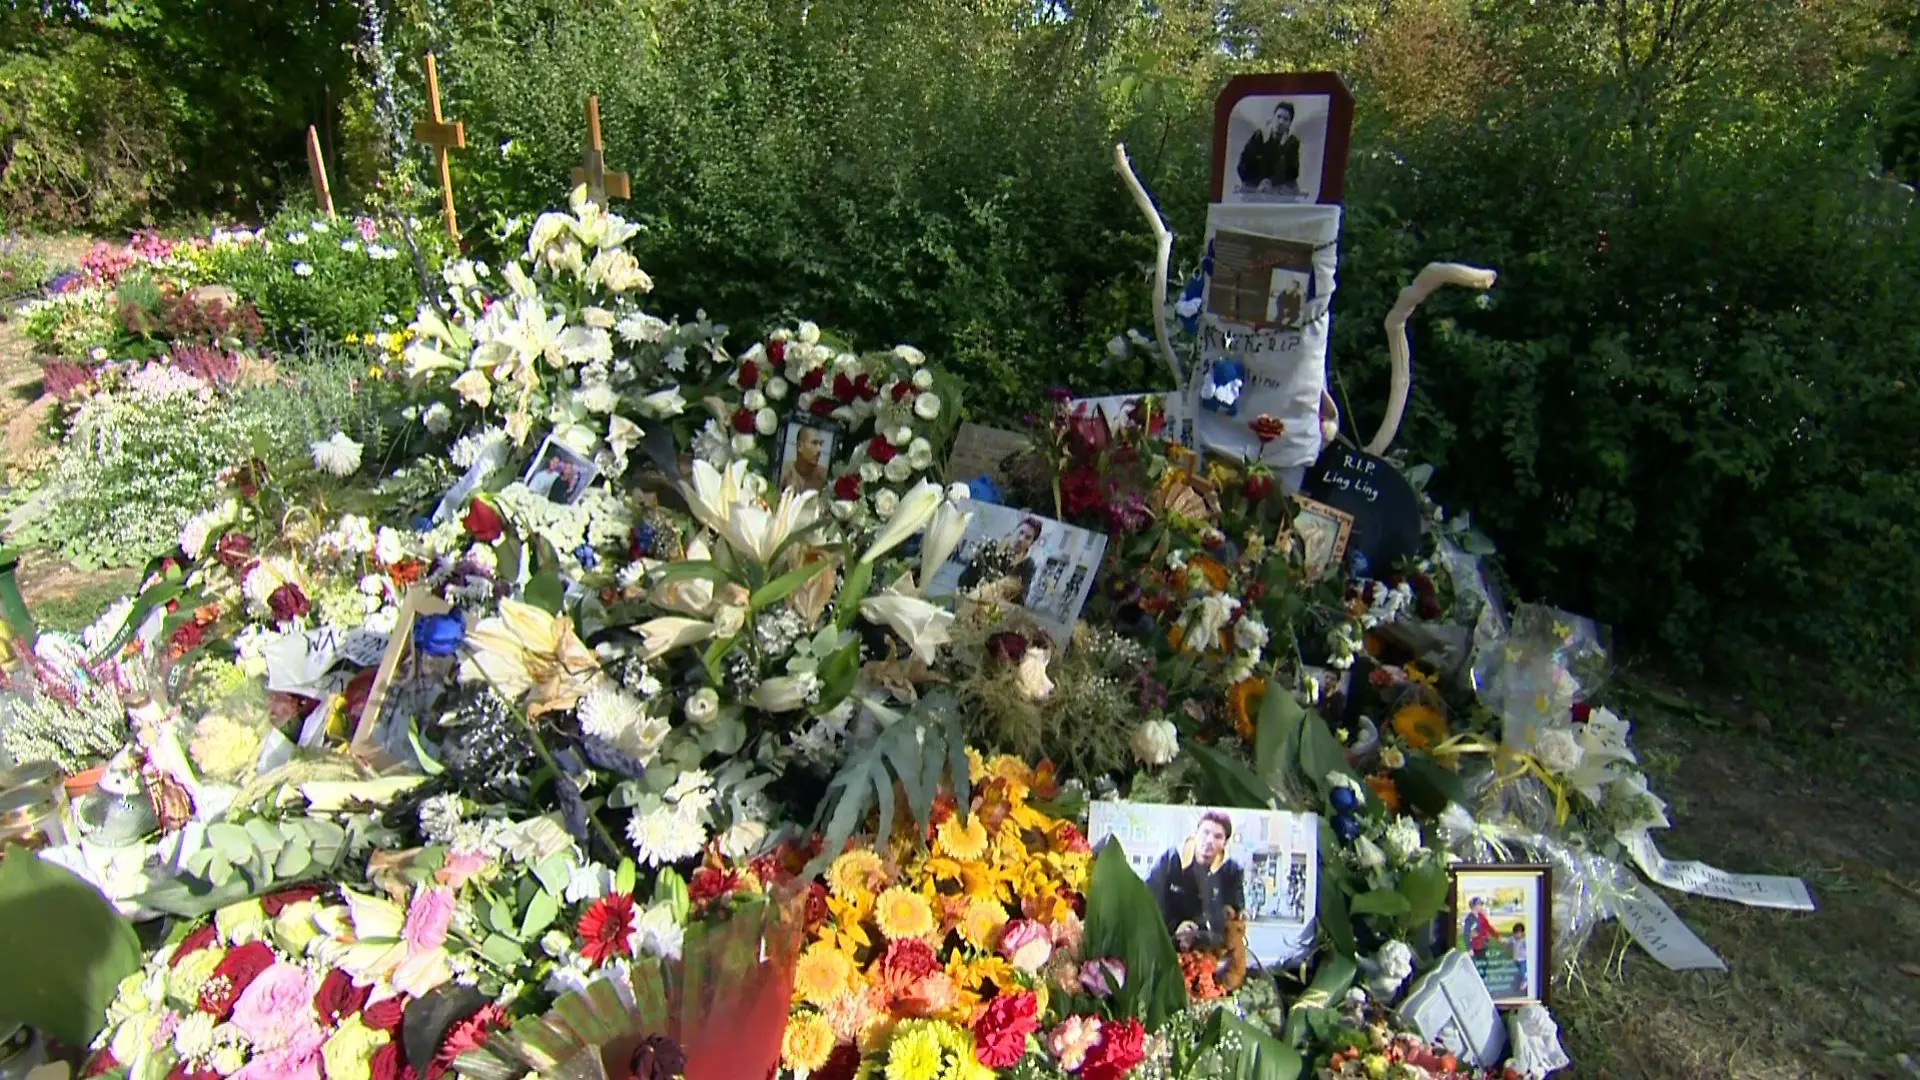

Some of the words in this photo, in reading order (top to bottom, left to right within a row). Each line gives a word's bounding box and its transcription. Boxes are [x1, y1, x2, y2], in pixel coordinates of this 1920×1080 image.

[1343, 454, 1377, 477] R.I.P.
[1322, 469, 1351, 491] Ling
[1354, 477, 1380, 503] Ling
